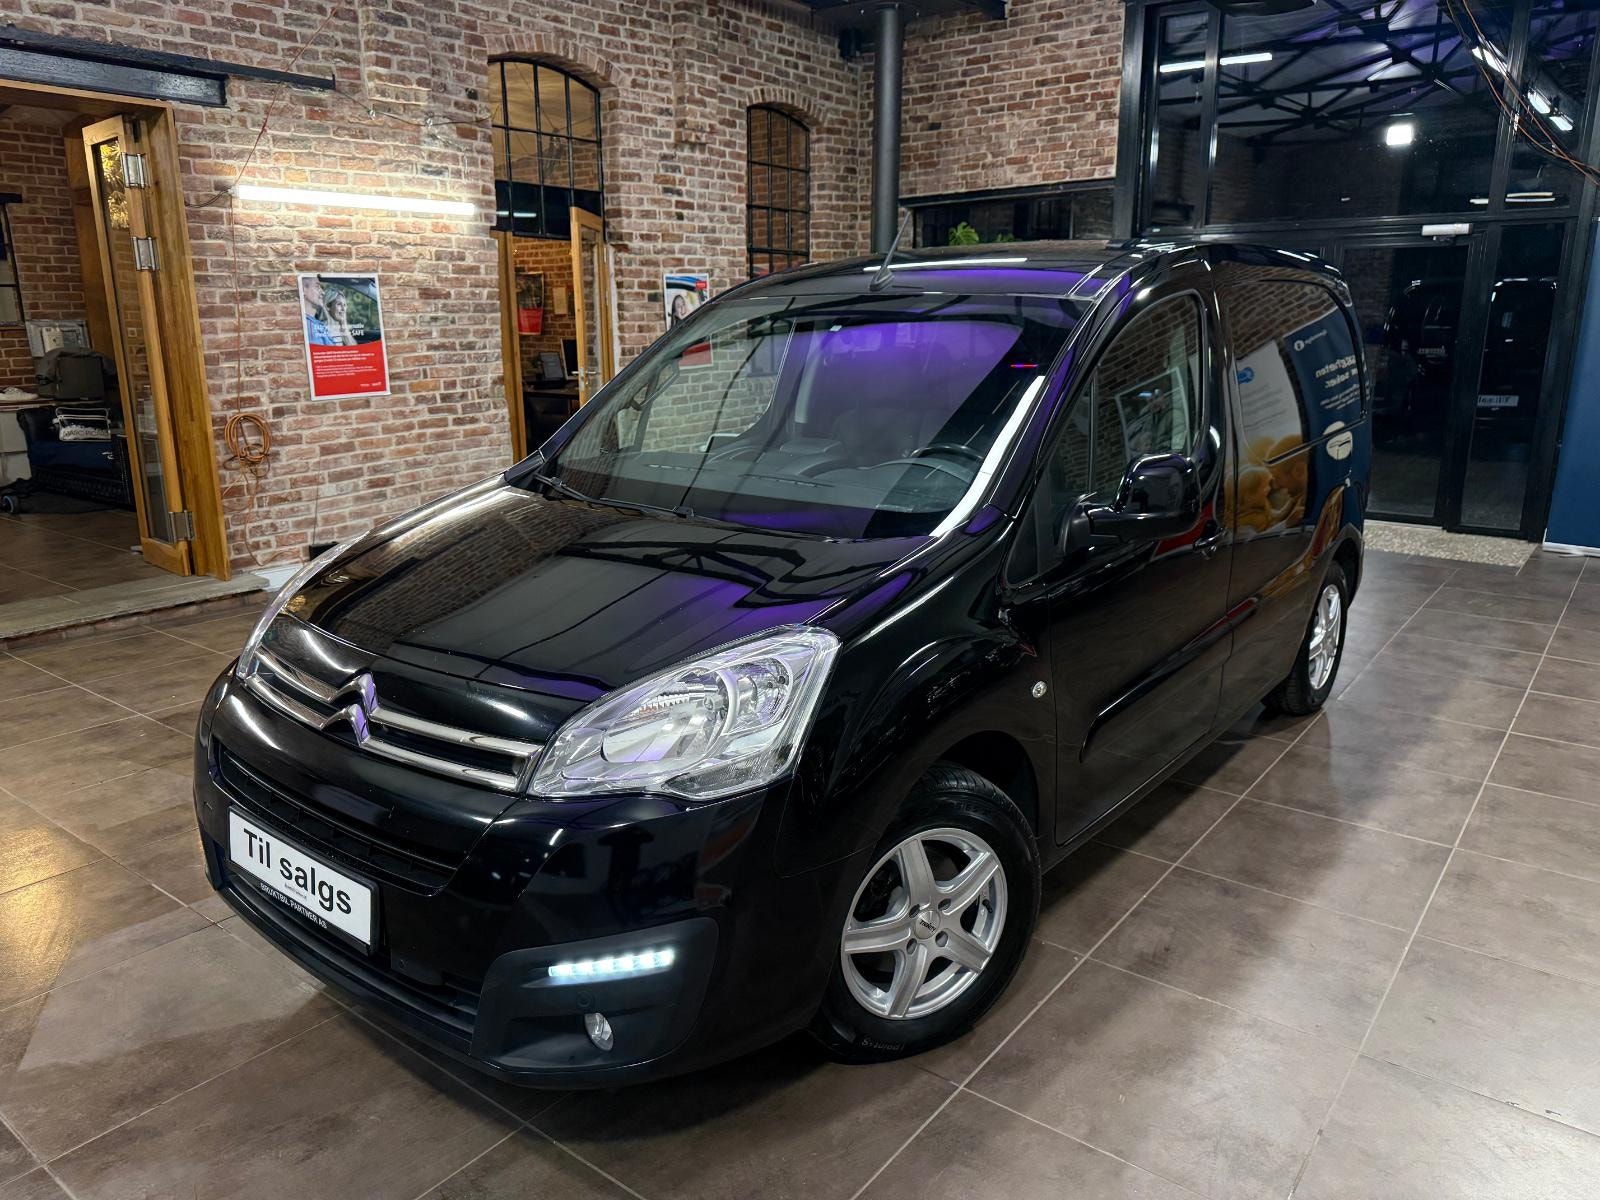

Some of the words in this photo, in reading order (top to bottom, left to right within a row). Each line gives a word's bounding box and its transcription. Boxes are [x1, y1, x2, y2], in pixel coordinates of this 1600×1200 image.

[243, 828, 271, 869] Til
[279, 857, 352, 915] salgs
[290, 901, 318, 924] PARTNER
